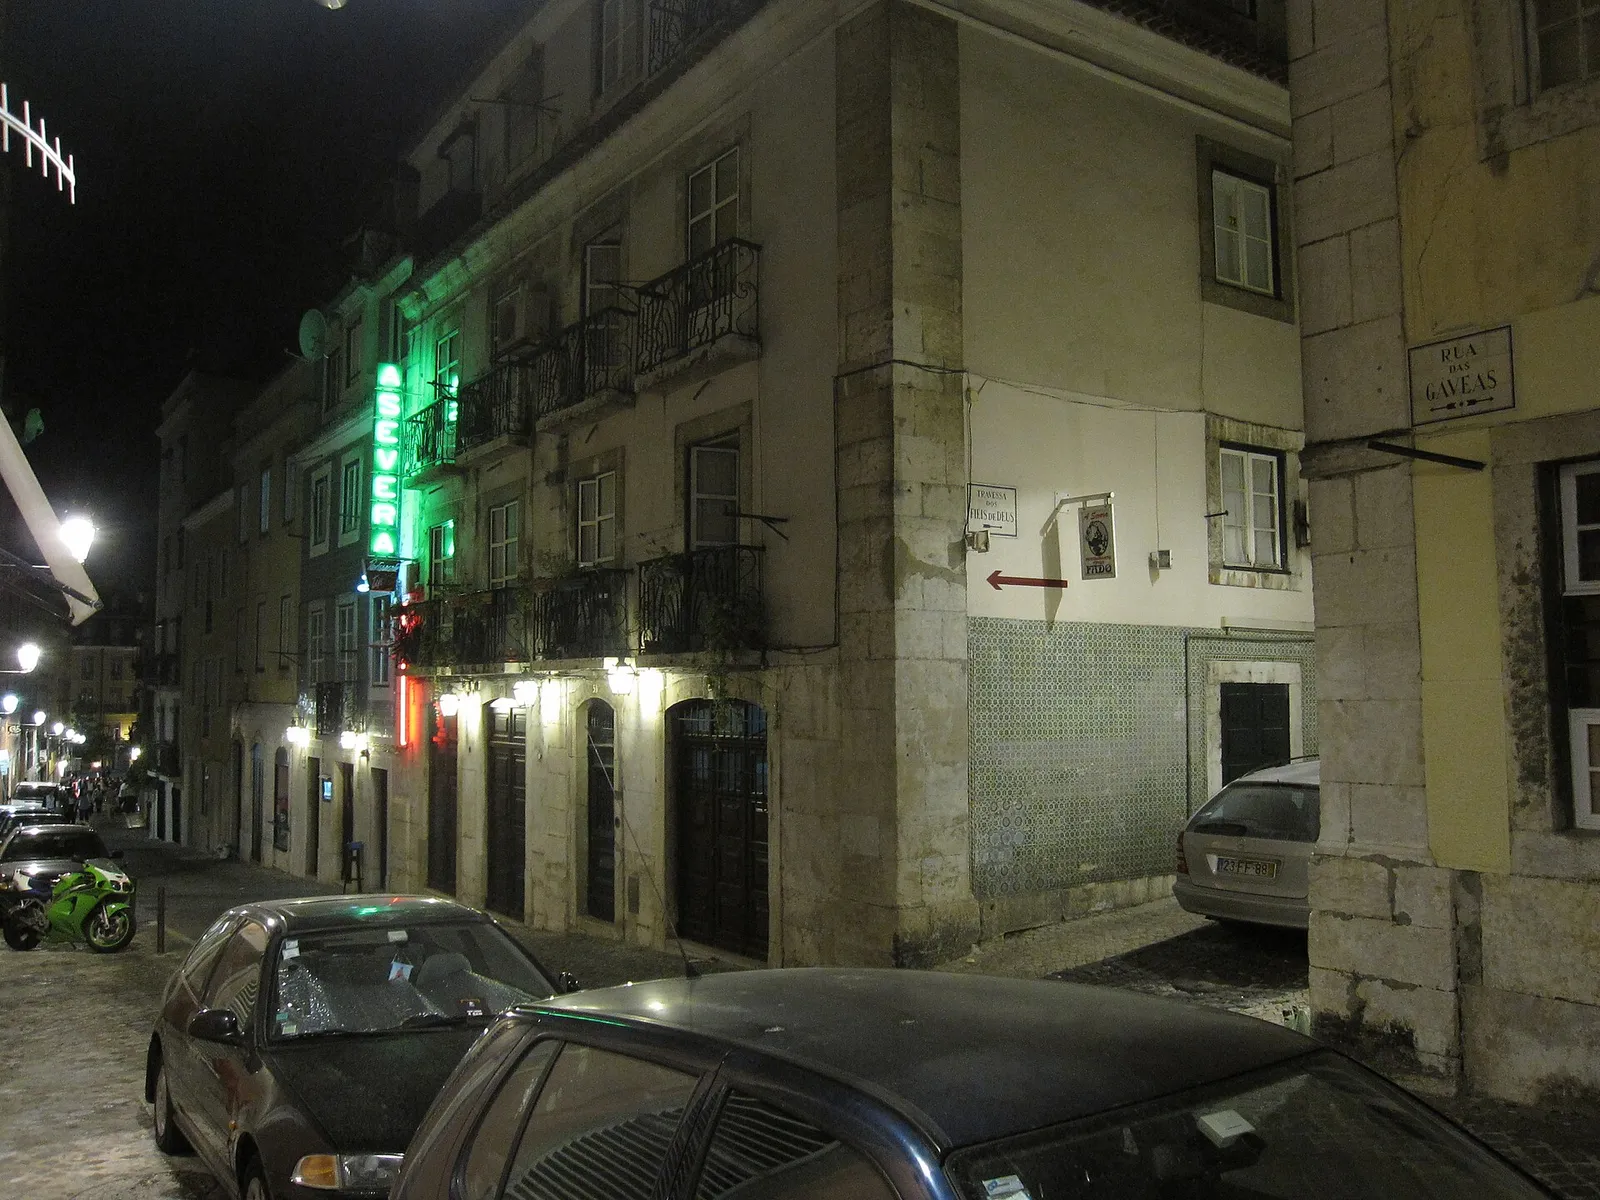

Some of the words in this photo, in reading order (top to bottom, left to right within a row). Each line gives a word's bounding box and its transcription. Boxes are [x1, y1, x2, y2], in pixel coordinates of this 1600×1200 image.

[1441, 343, 1477, 363] RUA
[1449, 361, 1470, 374] DAS
[977, 490, 1007, 500] TRAVESSA
[996, 511, 1015, 523] DEUS
[1086, 564, 1112, 575] FADO
